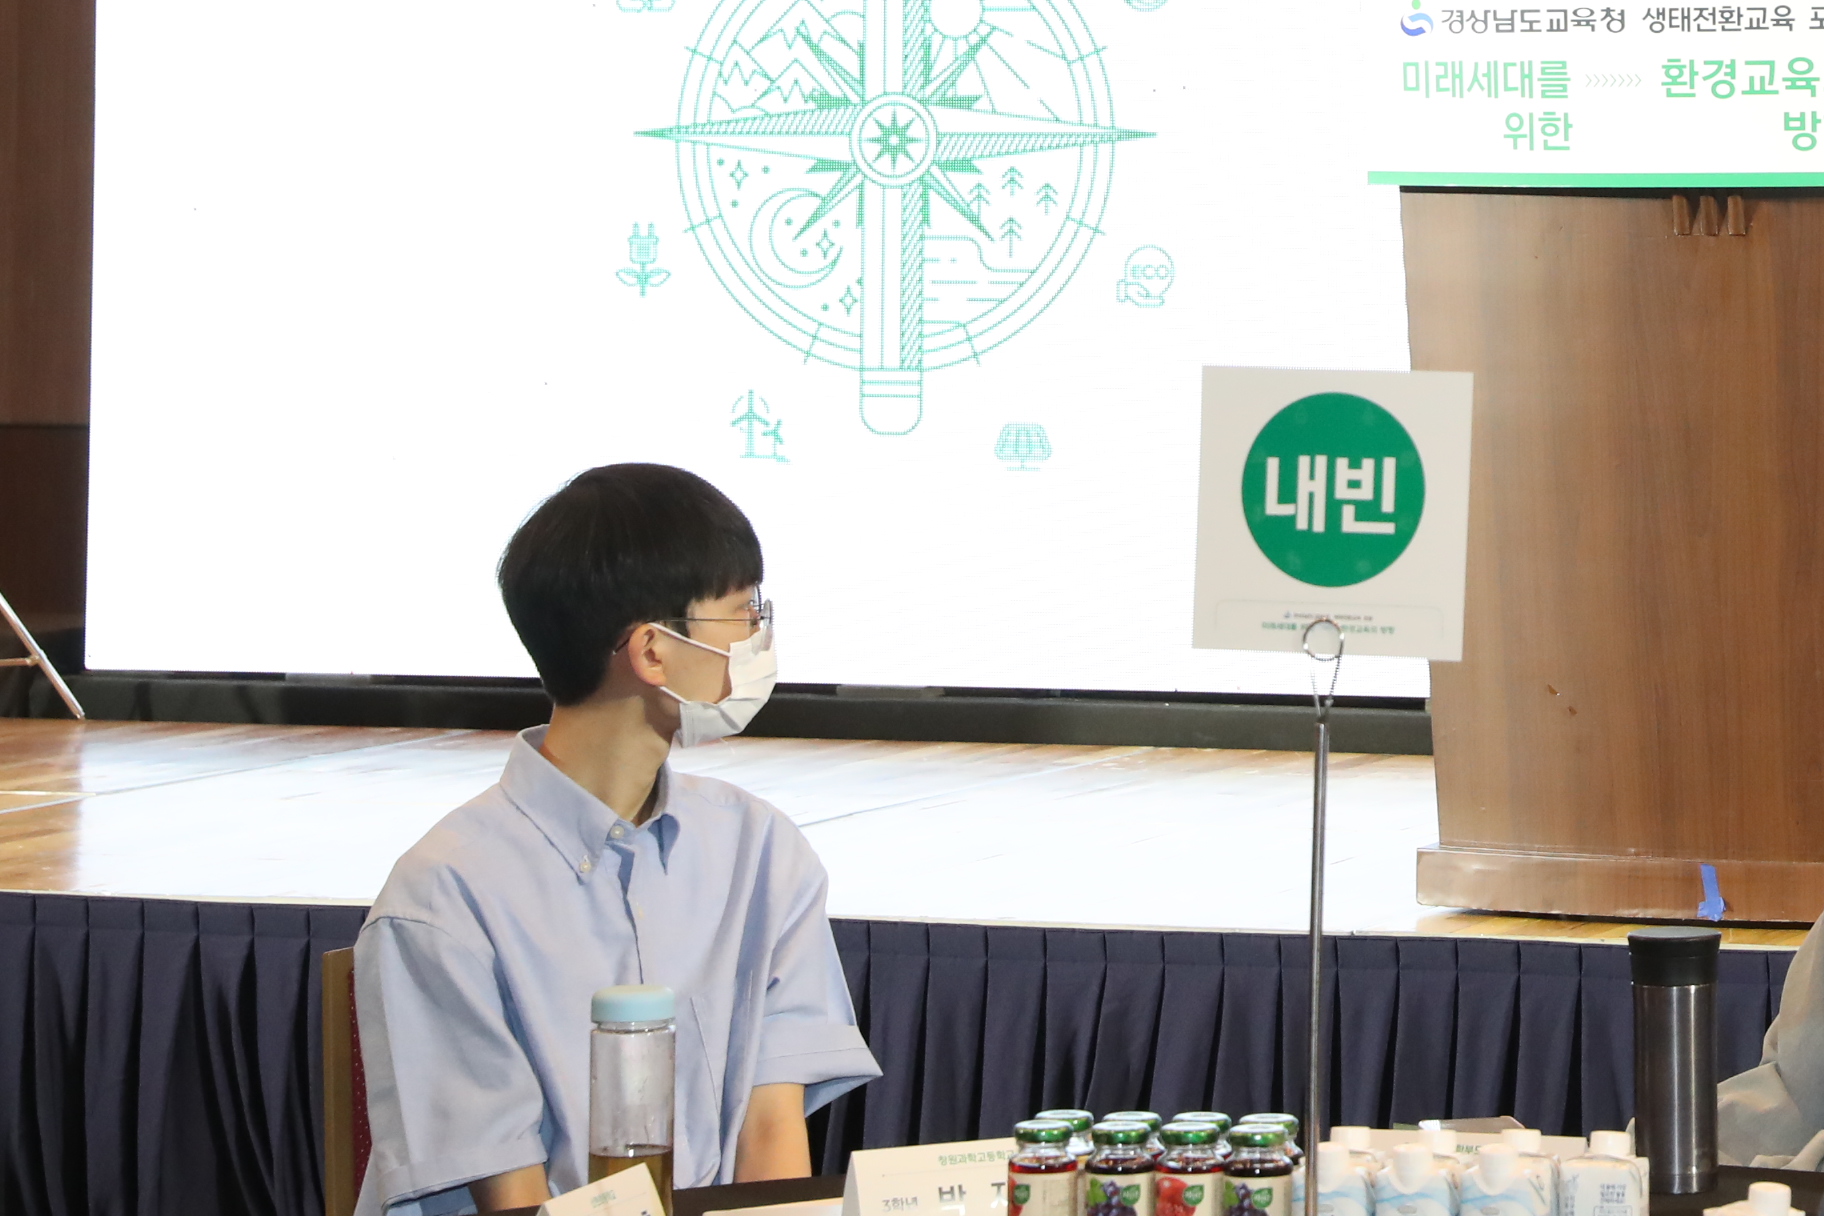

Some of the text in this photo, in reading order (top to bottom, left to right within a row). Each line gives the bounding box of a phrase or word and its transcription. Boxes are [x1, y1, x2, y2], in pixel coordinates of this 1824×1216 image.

[1441, 7, 1625, 34] 경상남도교육청
[1642, 5, 1796, 34] 생태전환교육
[1402, 60, 1572, 99] 미래세대를
[1503, 111, 1573, 151] 위한
[1265, 454, 1397, 534] 내빈
